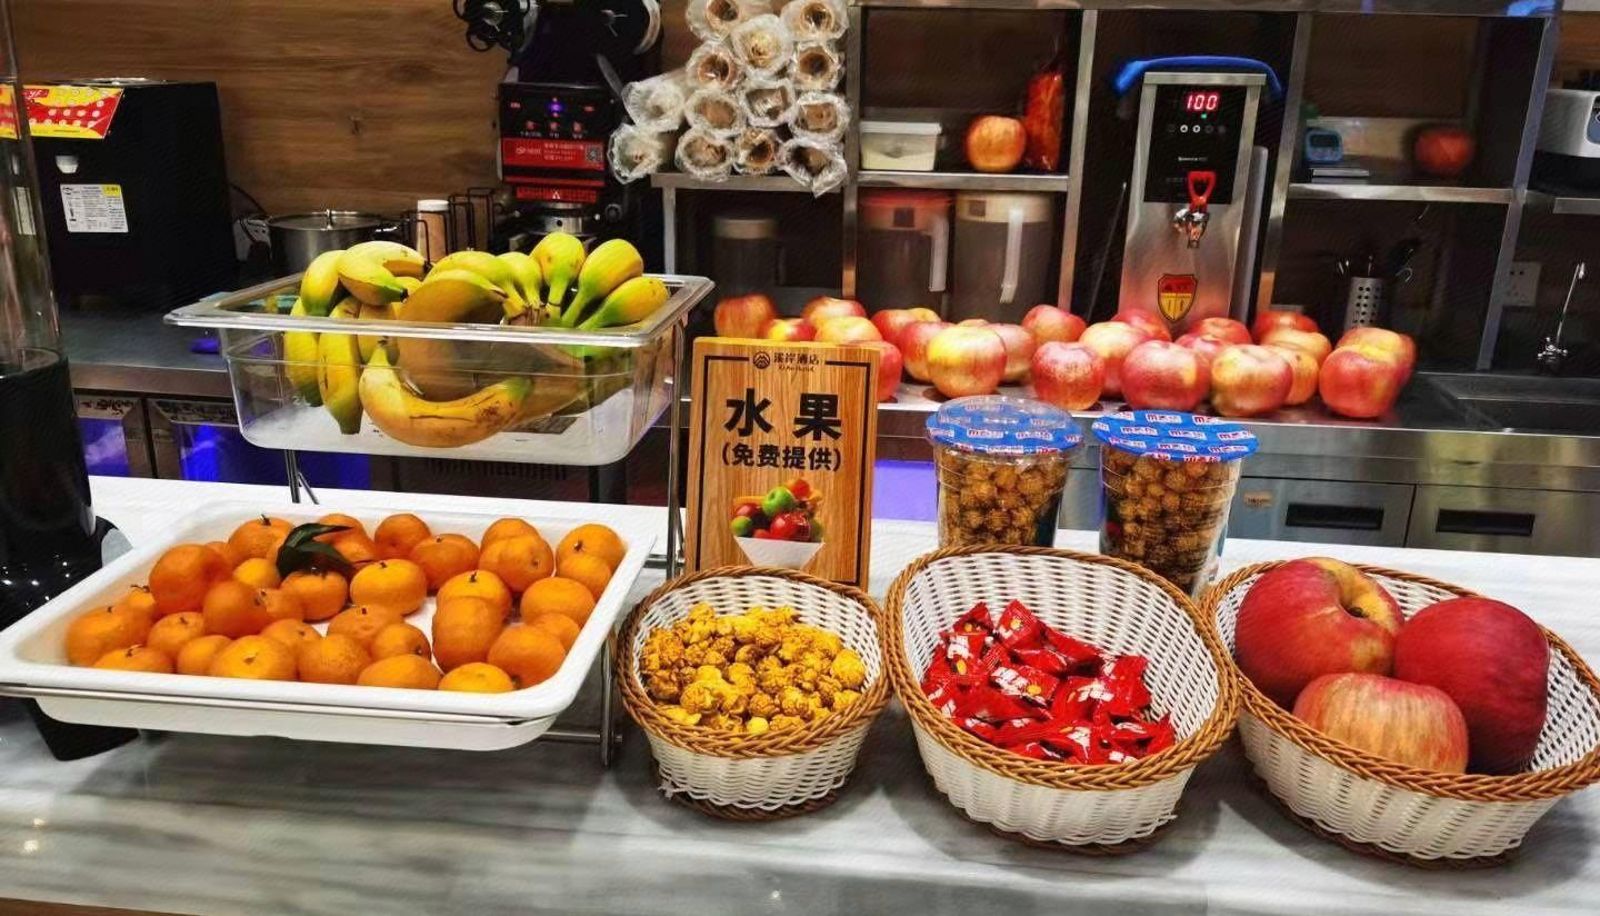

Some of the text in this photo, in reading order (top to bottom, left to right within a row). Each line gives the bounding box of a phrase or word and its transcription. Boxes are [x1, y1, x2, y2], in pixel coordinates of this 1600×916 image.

[1186, 94, 1218, 110] 100
[724, 388, 842, 441] 水果
[722, 442, 841, 472] (免费提供)
